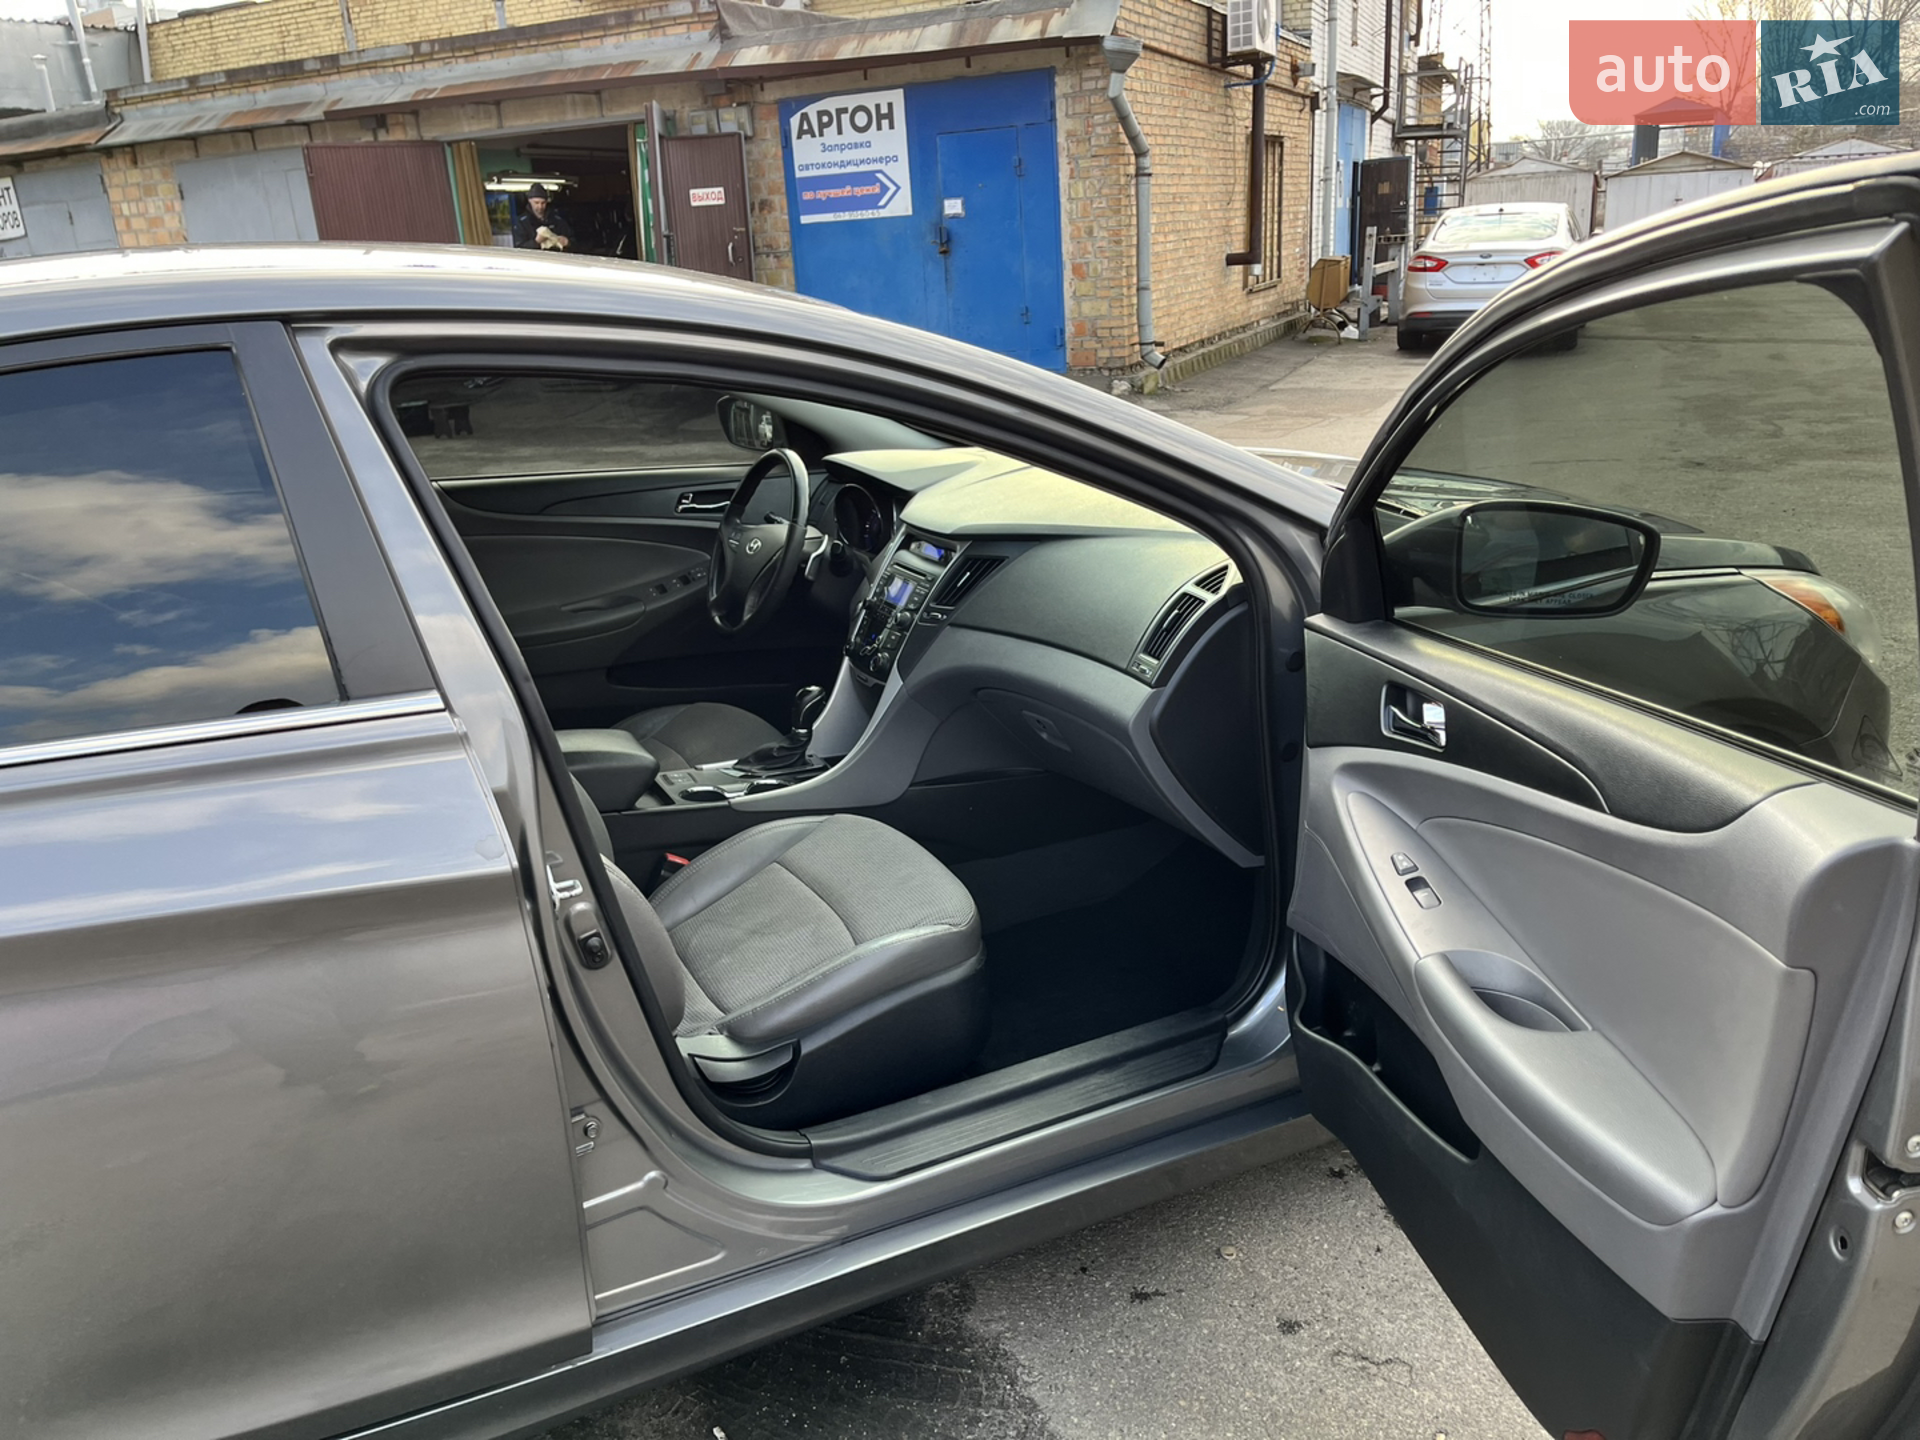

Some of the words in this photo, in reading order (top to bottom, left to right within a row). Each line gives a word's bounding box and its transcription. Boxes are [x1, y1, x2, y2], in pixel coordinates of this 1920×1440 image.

[796, 102, 895, 139] АРГОН
[820, 140, 871, 153] Заправка
[798, 155, 898, 171] автокондиционера
[692, 191, 723, 202] ВЫХОД
